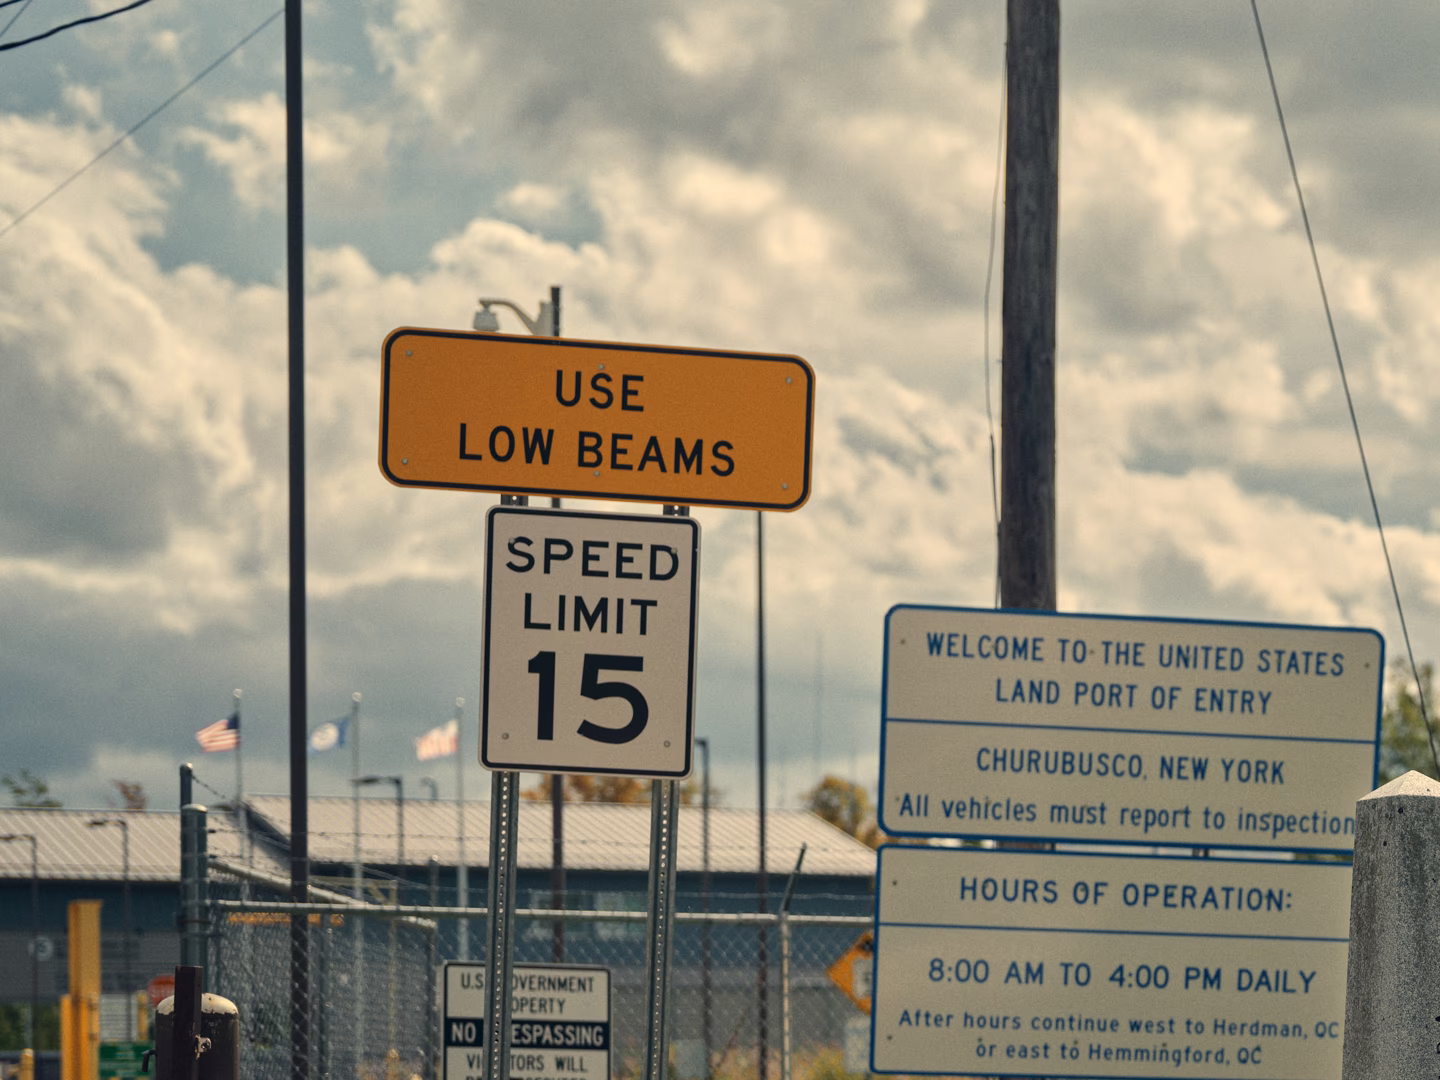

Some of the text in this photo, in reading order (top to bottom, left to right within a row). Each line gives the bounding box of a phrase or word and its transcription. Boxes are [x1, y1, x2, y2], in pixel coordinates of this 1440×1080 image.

[555, 369, 645, 412] USE
[458, 422, 736, 477] LOW BEAMS
[505, 536, 680, 581] SPEED
[523, 592, 658, 635] LIMIT
[926, 632, 1345, 677] WELCOME TO THE UNITED STATES
[527, 650, 650, 744] 15
[995, 678, 1273, 715] LAND PORT OF ENTRY
[976, 747, 1284, 785] CHURUBUSCO, NEW YORK
[899, 794, 1355, 839] All vehicles must report to inspection
[960, 877, 1292, 912] HOURS OF OPERATION:
[512, 975, 595, 993] OVERNMENT
[928, 958, 1317, 994] 8:00 AM TO 4:00 PM DAILY
[512, 997, 566, 1014] OPERTY
[452, 1022, 603, 1046] NO ESPASSING
[899, 1009, 1340, 1040] After hours continue west to Herdman, QC
[555, 1056, 588, 1073] WILL
[975, 1042, 1262, 1068] or east to Hemmingford, QC
